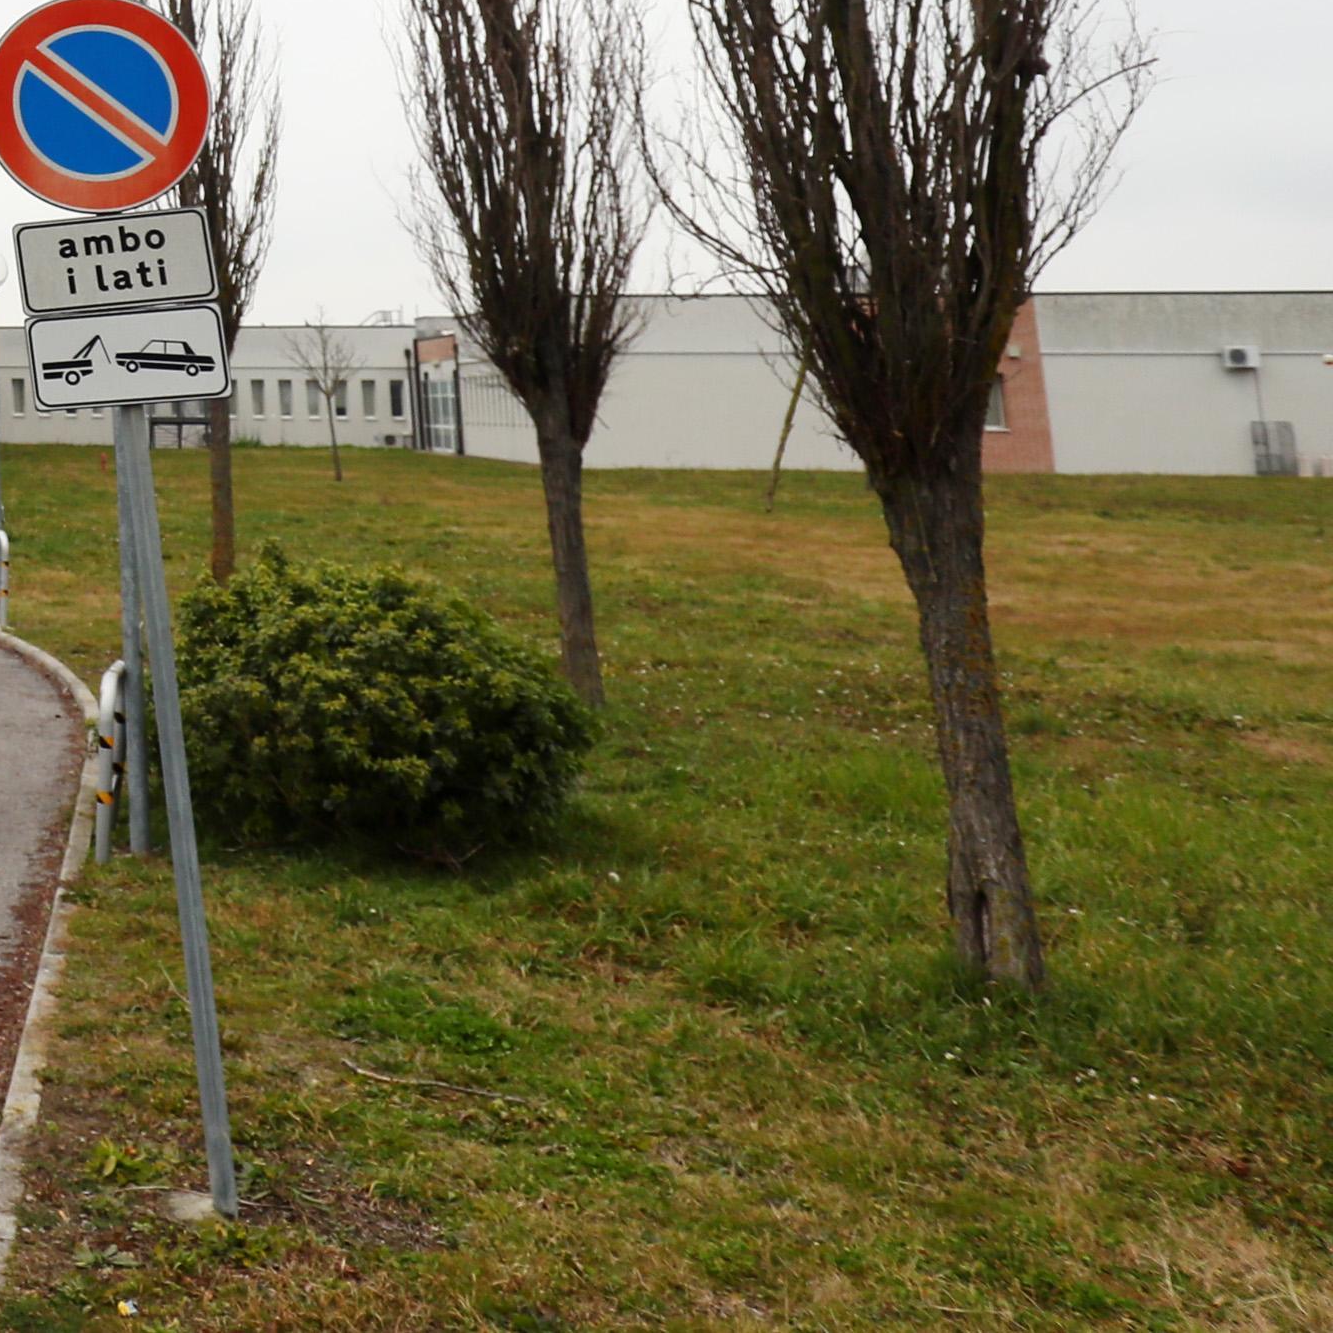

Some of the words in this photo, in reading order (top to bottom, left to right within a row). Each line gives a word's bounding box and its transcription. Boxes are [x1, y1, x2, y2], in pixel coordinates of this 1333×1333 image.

[58, 225, 166, 259] ambo
[66, 267, 77, 295] i
[95, 258, 168, 292] lati
